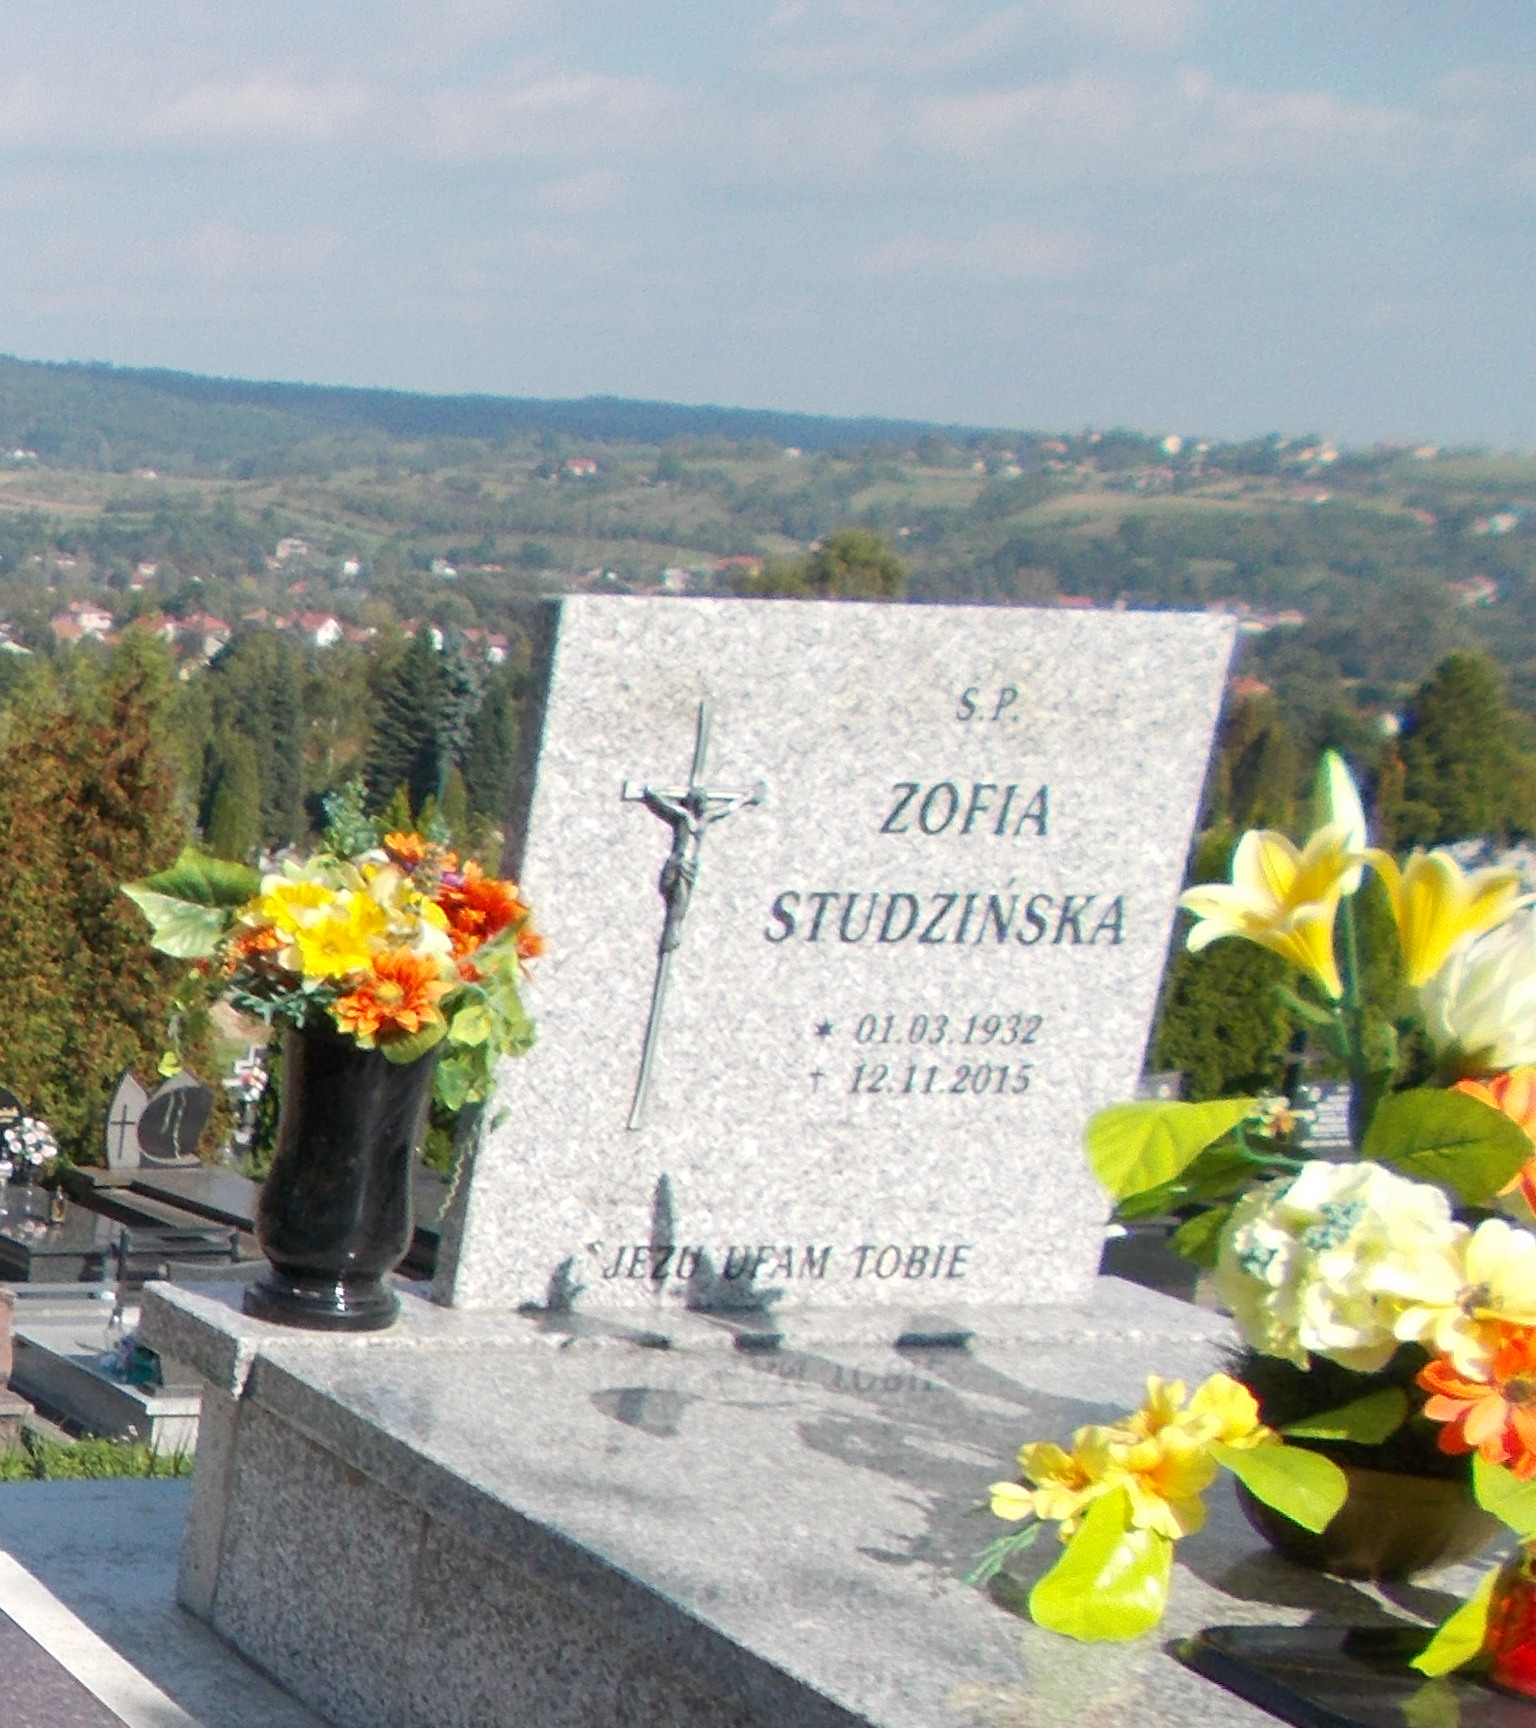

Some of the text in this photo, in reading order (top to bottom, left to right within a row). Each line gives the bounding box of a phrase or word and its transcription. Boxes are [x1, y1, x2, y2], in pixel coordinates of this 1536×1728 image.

[880, 782, 1052, 836] ZOFIA
[765, 877, 1127, 946] STUDZIŃSKA
[855, 1012, 1044, 1046] 01.03.1932
[850, 1062, 1034, 1095] 12.11.2015
[602, 1244, 973, 1281] JEZU UFAM TOBIE
